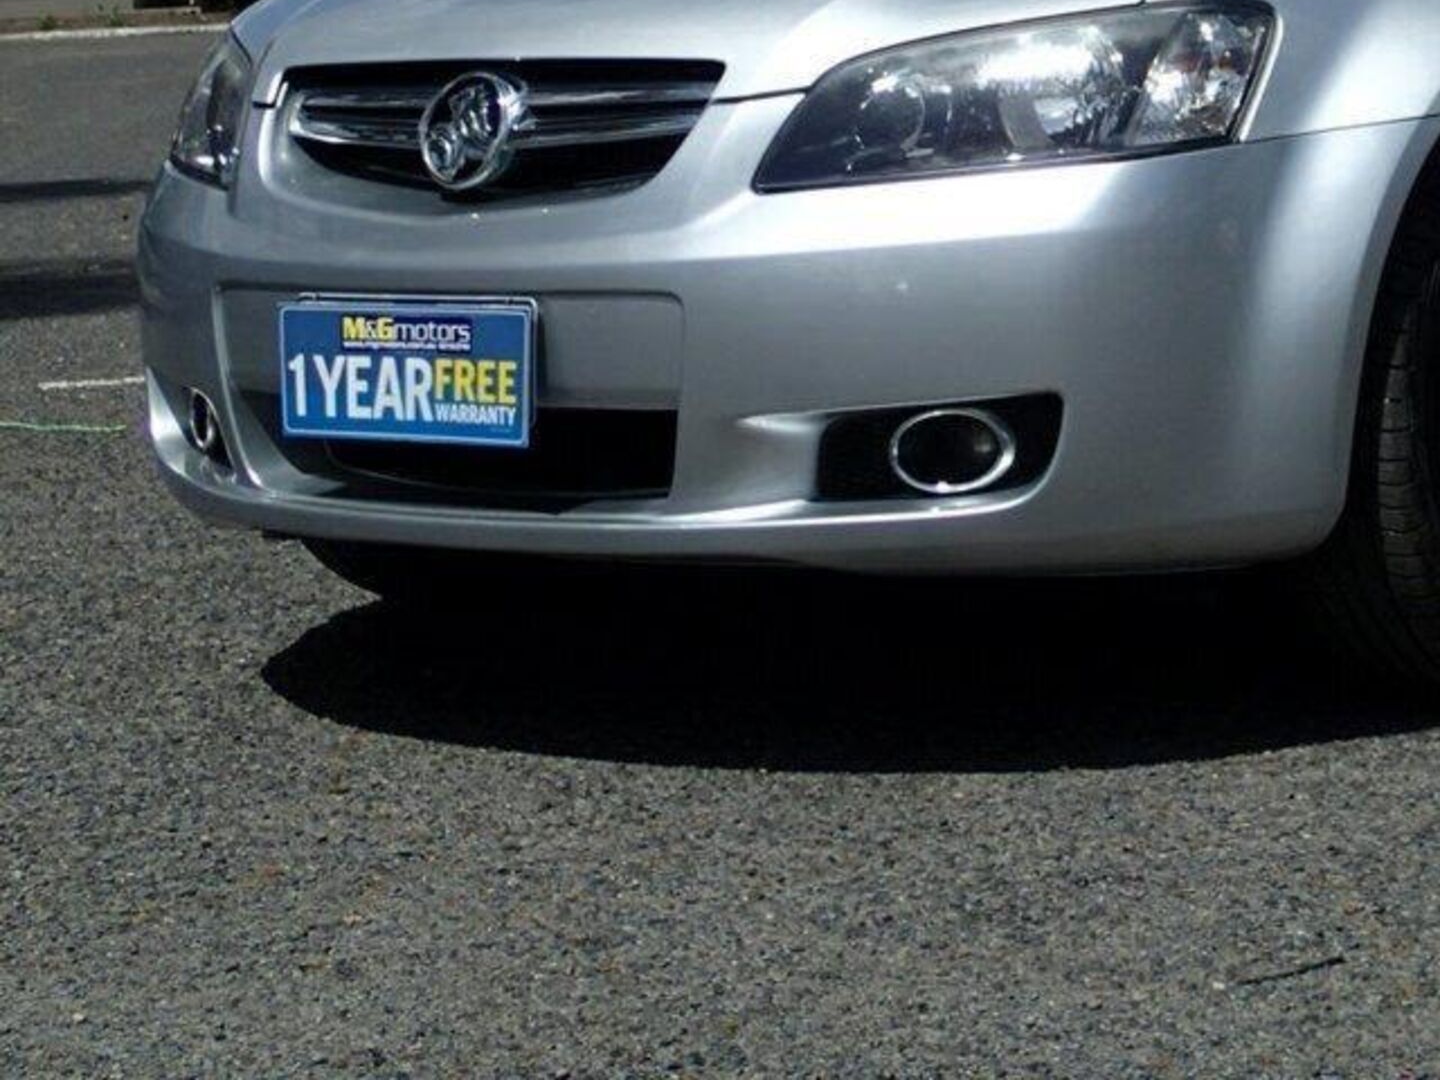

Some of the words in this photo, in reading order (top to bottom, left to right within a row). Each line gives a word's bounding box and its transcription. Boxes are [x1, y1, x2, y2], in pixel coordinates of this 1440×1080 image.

[289, 354, 307, 418] 1
[313, 355, 433, 422] YEAR
[435, 358, 516, 404] FREE
[435, 403, 516, 426] WARRANTY
